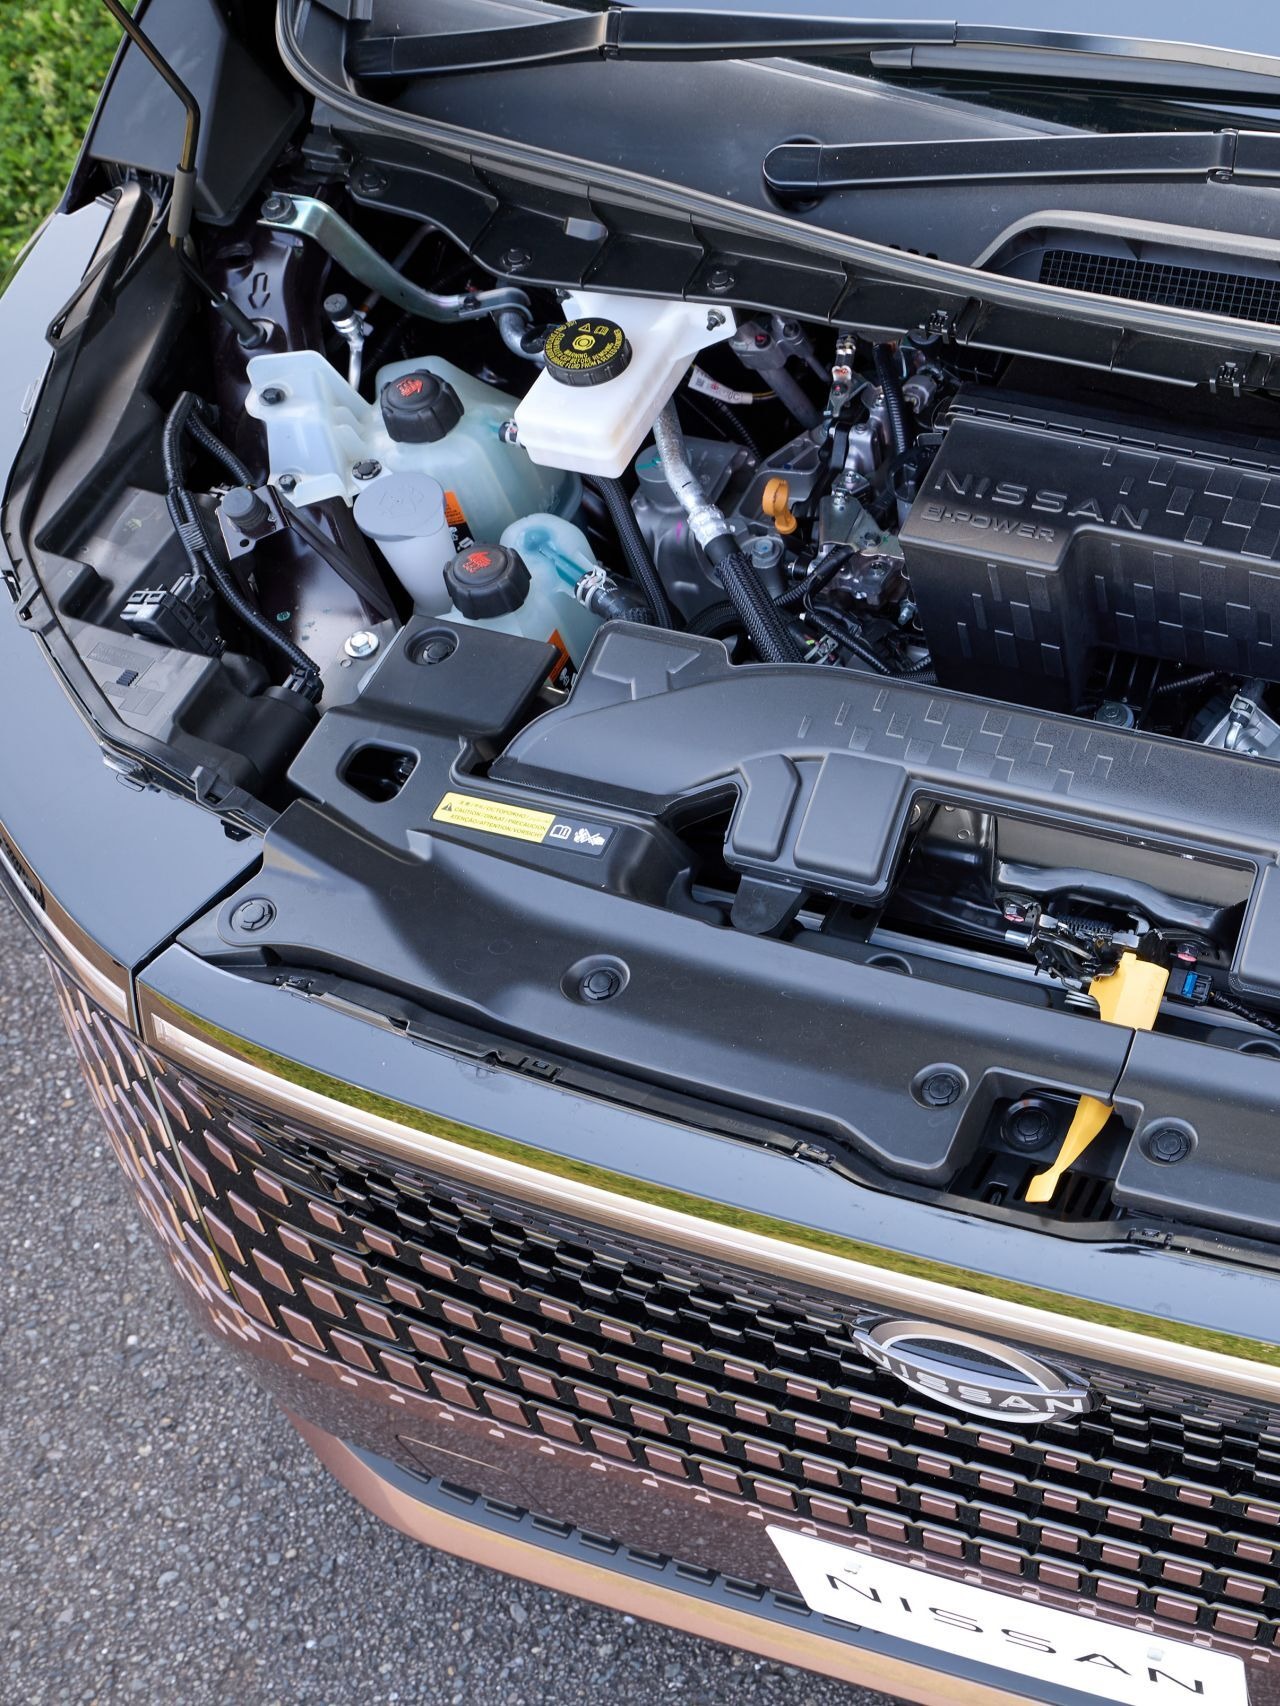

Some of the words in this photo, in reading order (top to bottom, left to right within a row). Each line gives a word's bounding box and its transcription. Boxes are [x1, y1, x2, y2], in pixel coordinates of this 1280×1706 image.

[934, 468, 1149, 530] NISSAN
[858, 1342, 1084, 1413] NISSAN
[825, 1574, 1205, 1696] NISSAN
